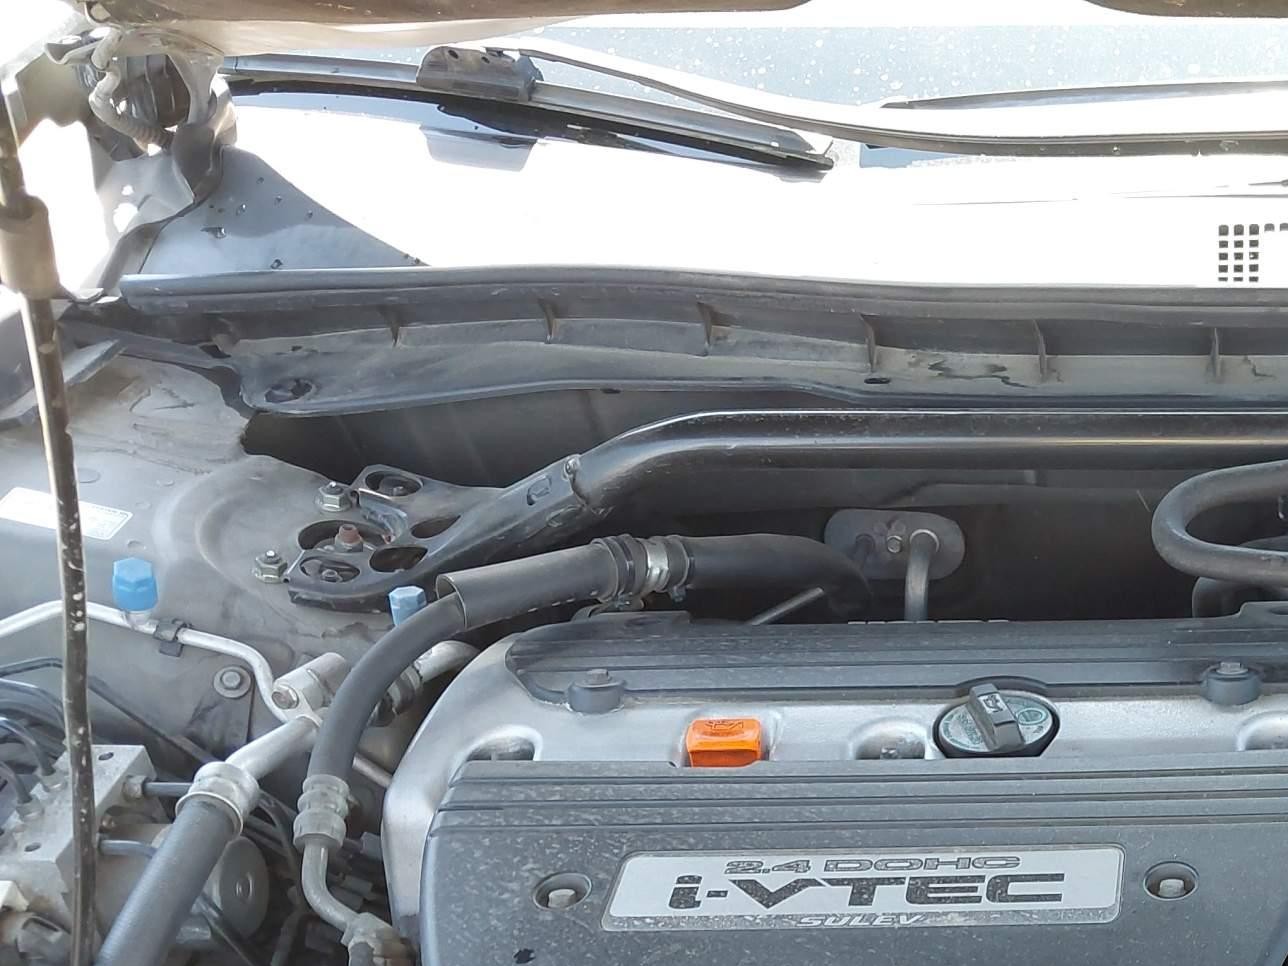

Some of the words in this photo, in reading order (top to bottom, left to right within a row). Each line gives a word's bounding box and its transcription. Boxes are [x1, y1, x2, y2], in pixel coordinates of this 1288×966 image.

[724, 857, 811, 875] 2.4
[824, 855, 1021, 873] DOHC
[668, 873, 1065, 910] i-VTEC
[797, 913, 927, 928] SULEV
